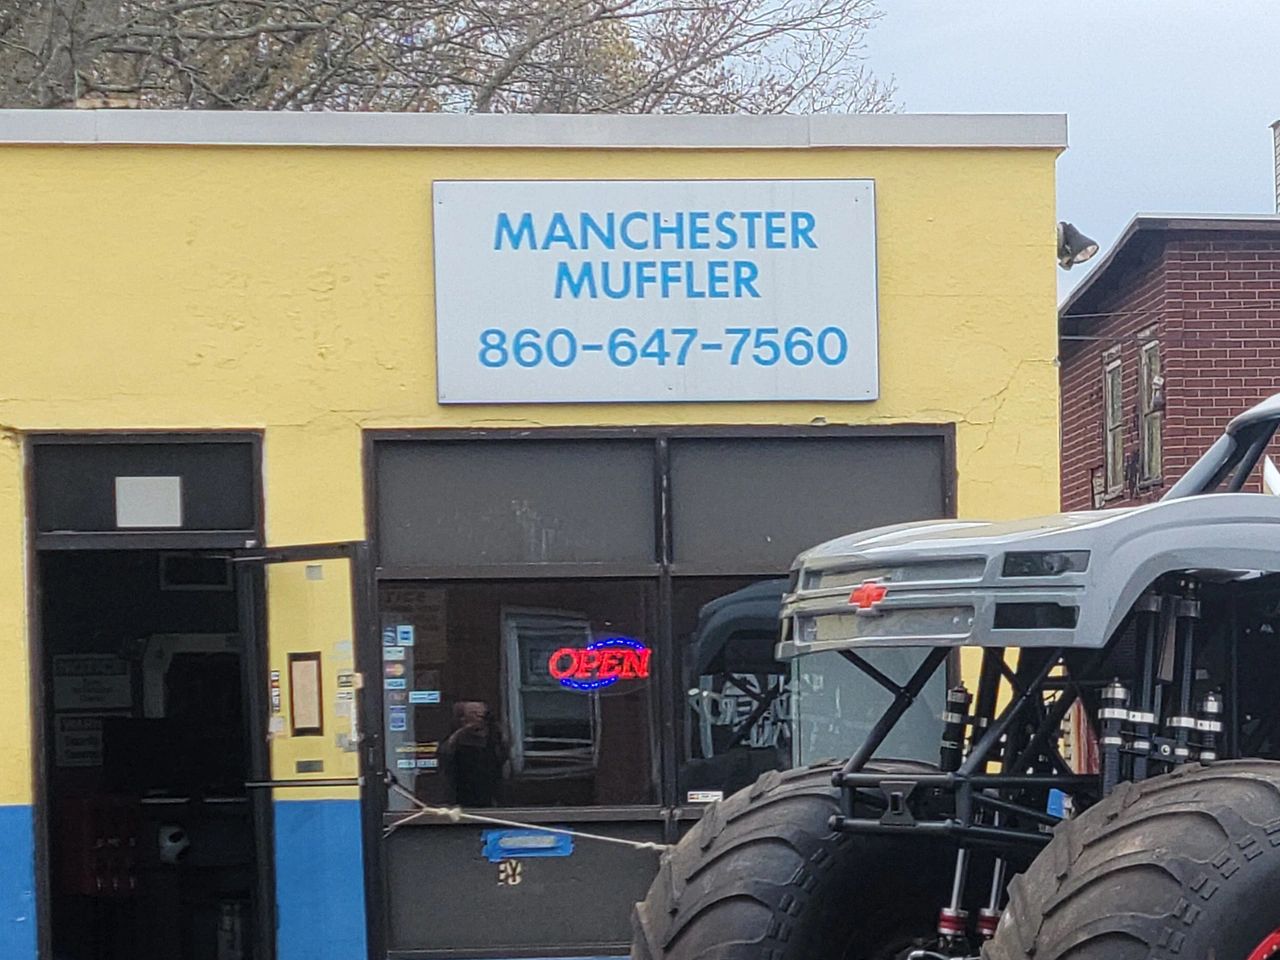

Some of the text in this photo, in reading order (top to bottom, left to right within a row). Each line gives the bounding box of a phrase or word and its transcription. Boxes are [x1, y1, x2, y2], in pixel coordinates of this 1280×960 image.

[493, 211, 818, 250] MANCHESTER
[554, 260, 761, 299] MUFFLER
[478, 326, 849, 368] 860-647-7560
[548, 647, 652, 680] OPEN
